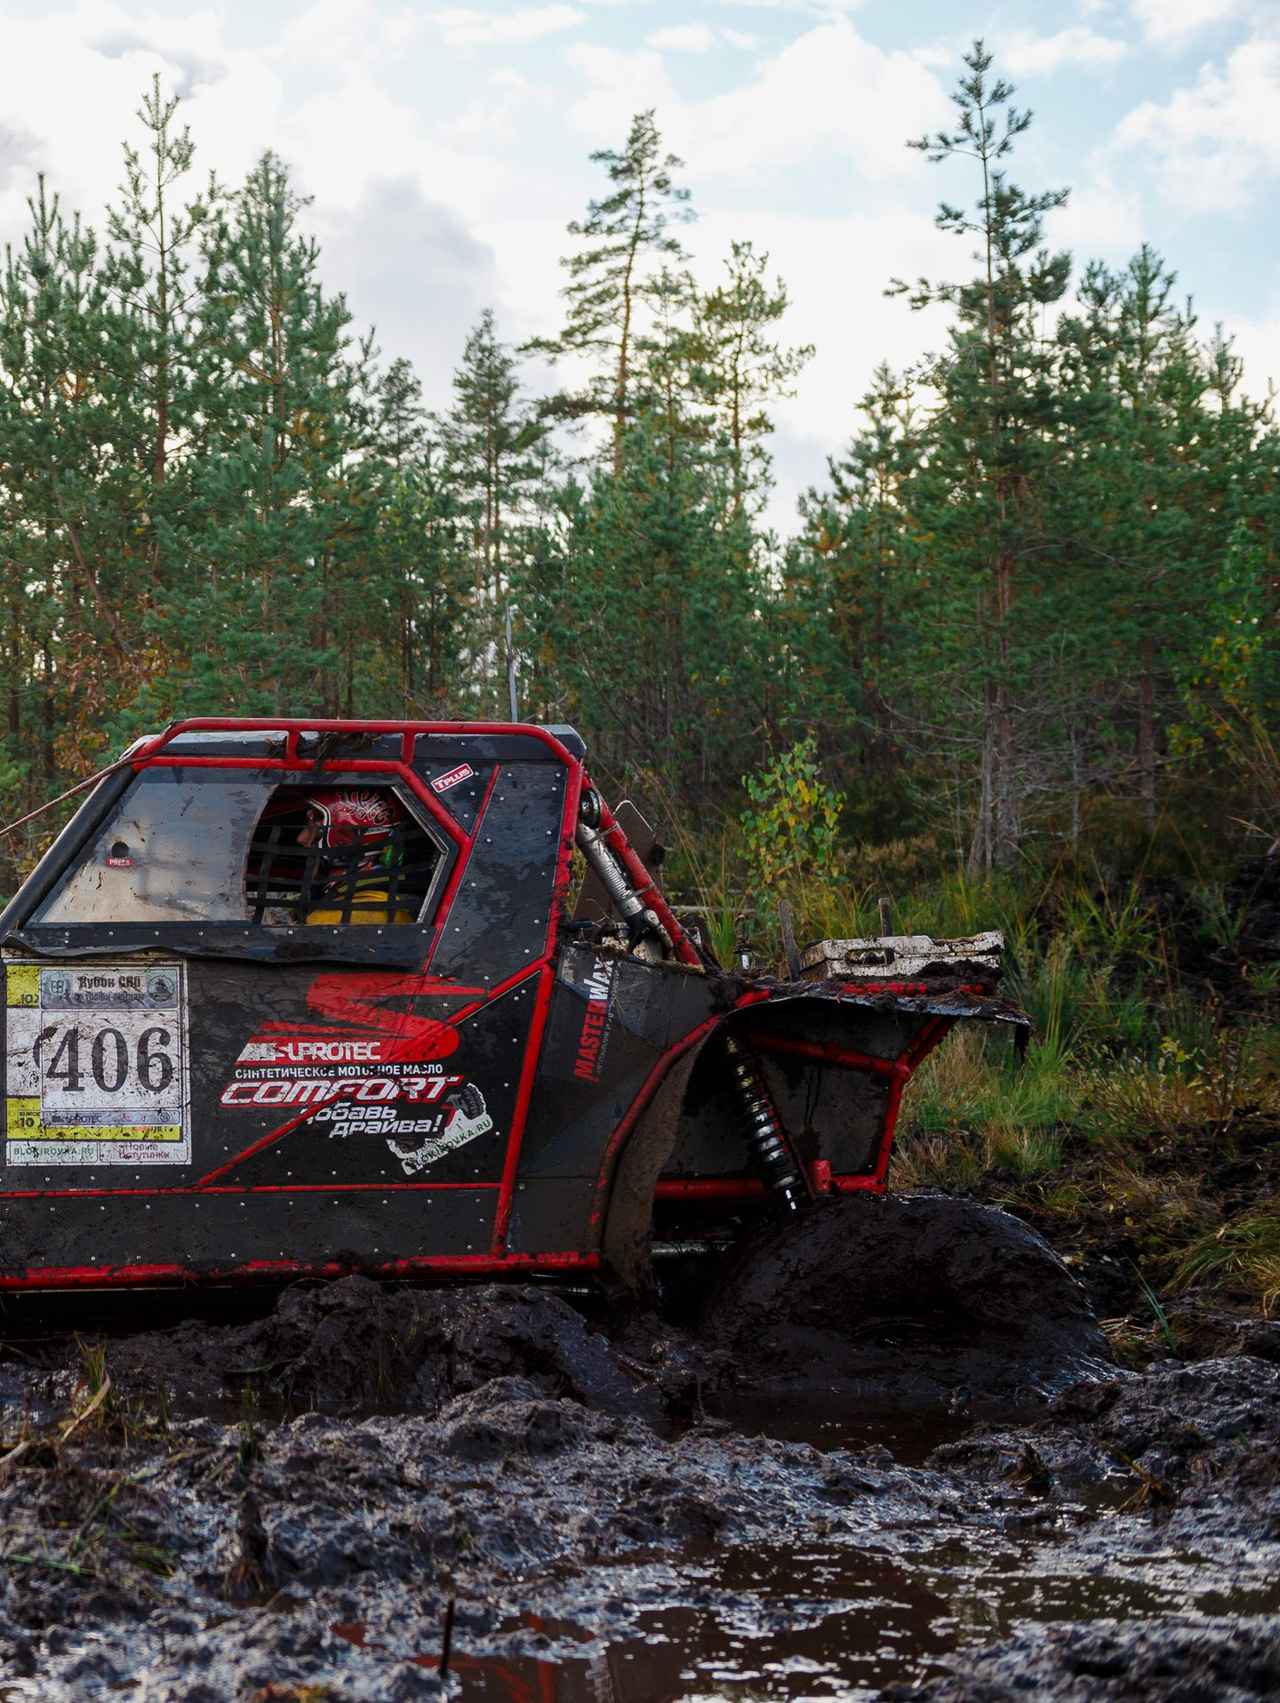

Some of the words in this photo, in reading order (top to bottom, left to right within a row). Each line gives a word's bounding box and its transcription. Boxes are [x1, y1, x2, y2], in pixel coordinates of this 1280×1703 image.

[434, 768, 471, 789] TPLUS
[46, 1027, 173, 1092] 406
[403, 1064, 443, 1075] МАСЛО
[220, 1077, 459, 1104] COMFORT
[329, 1114, 443, 1138] драйва!
